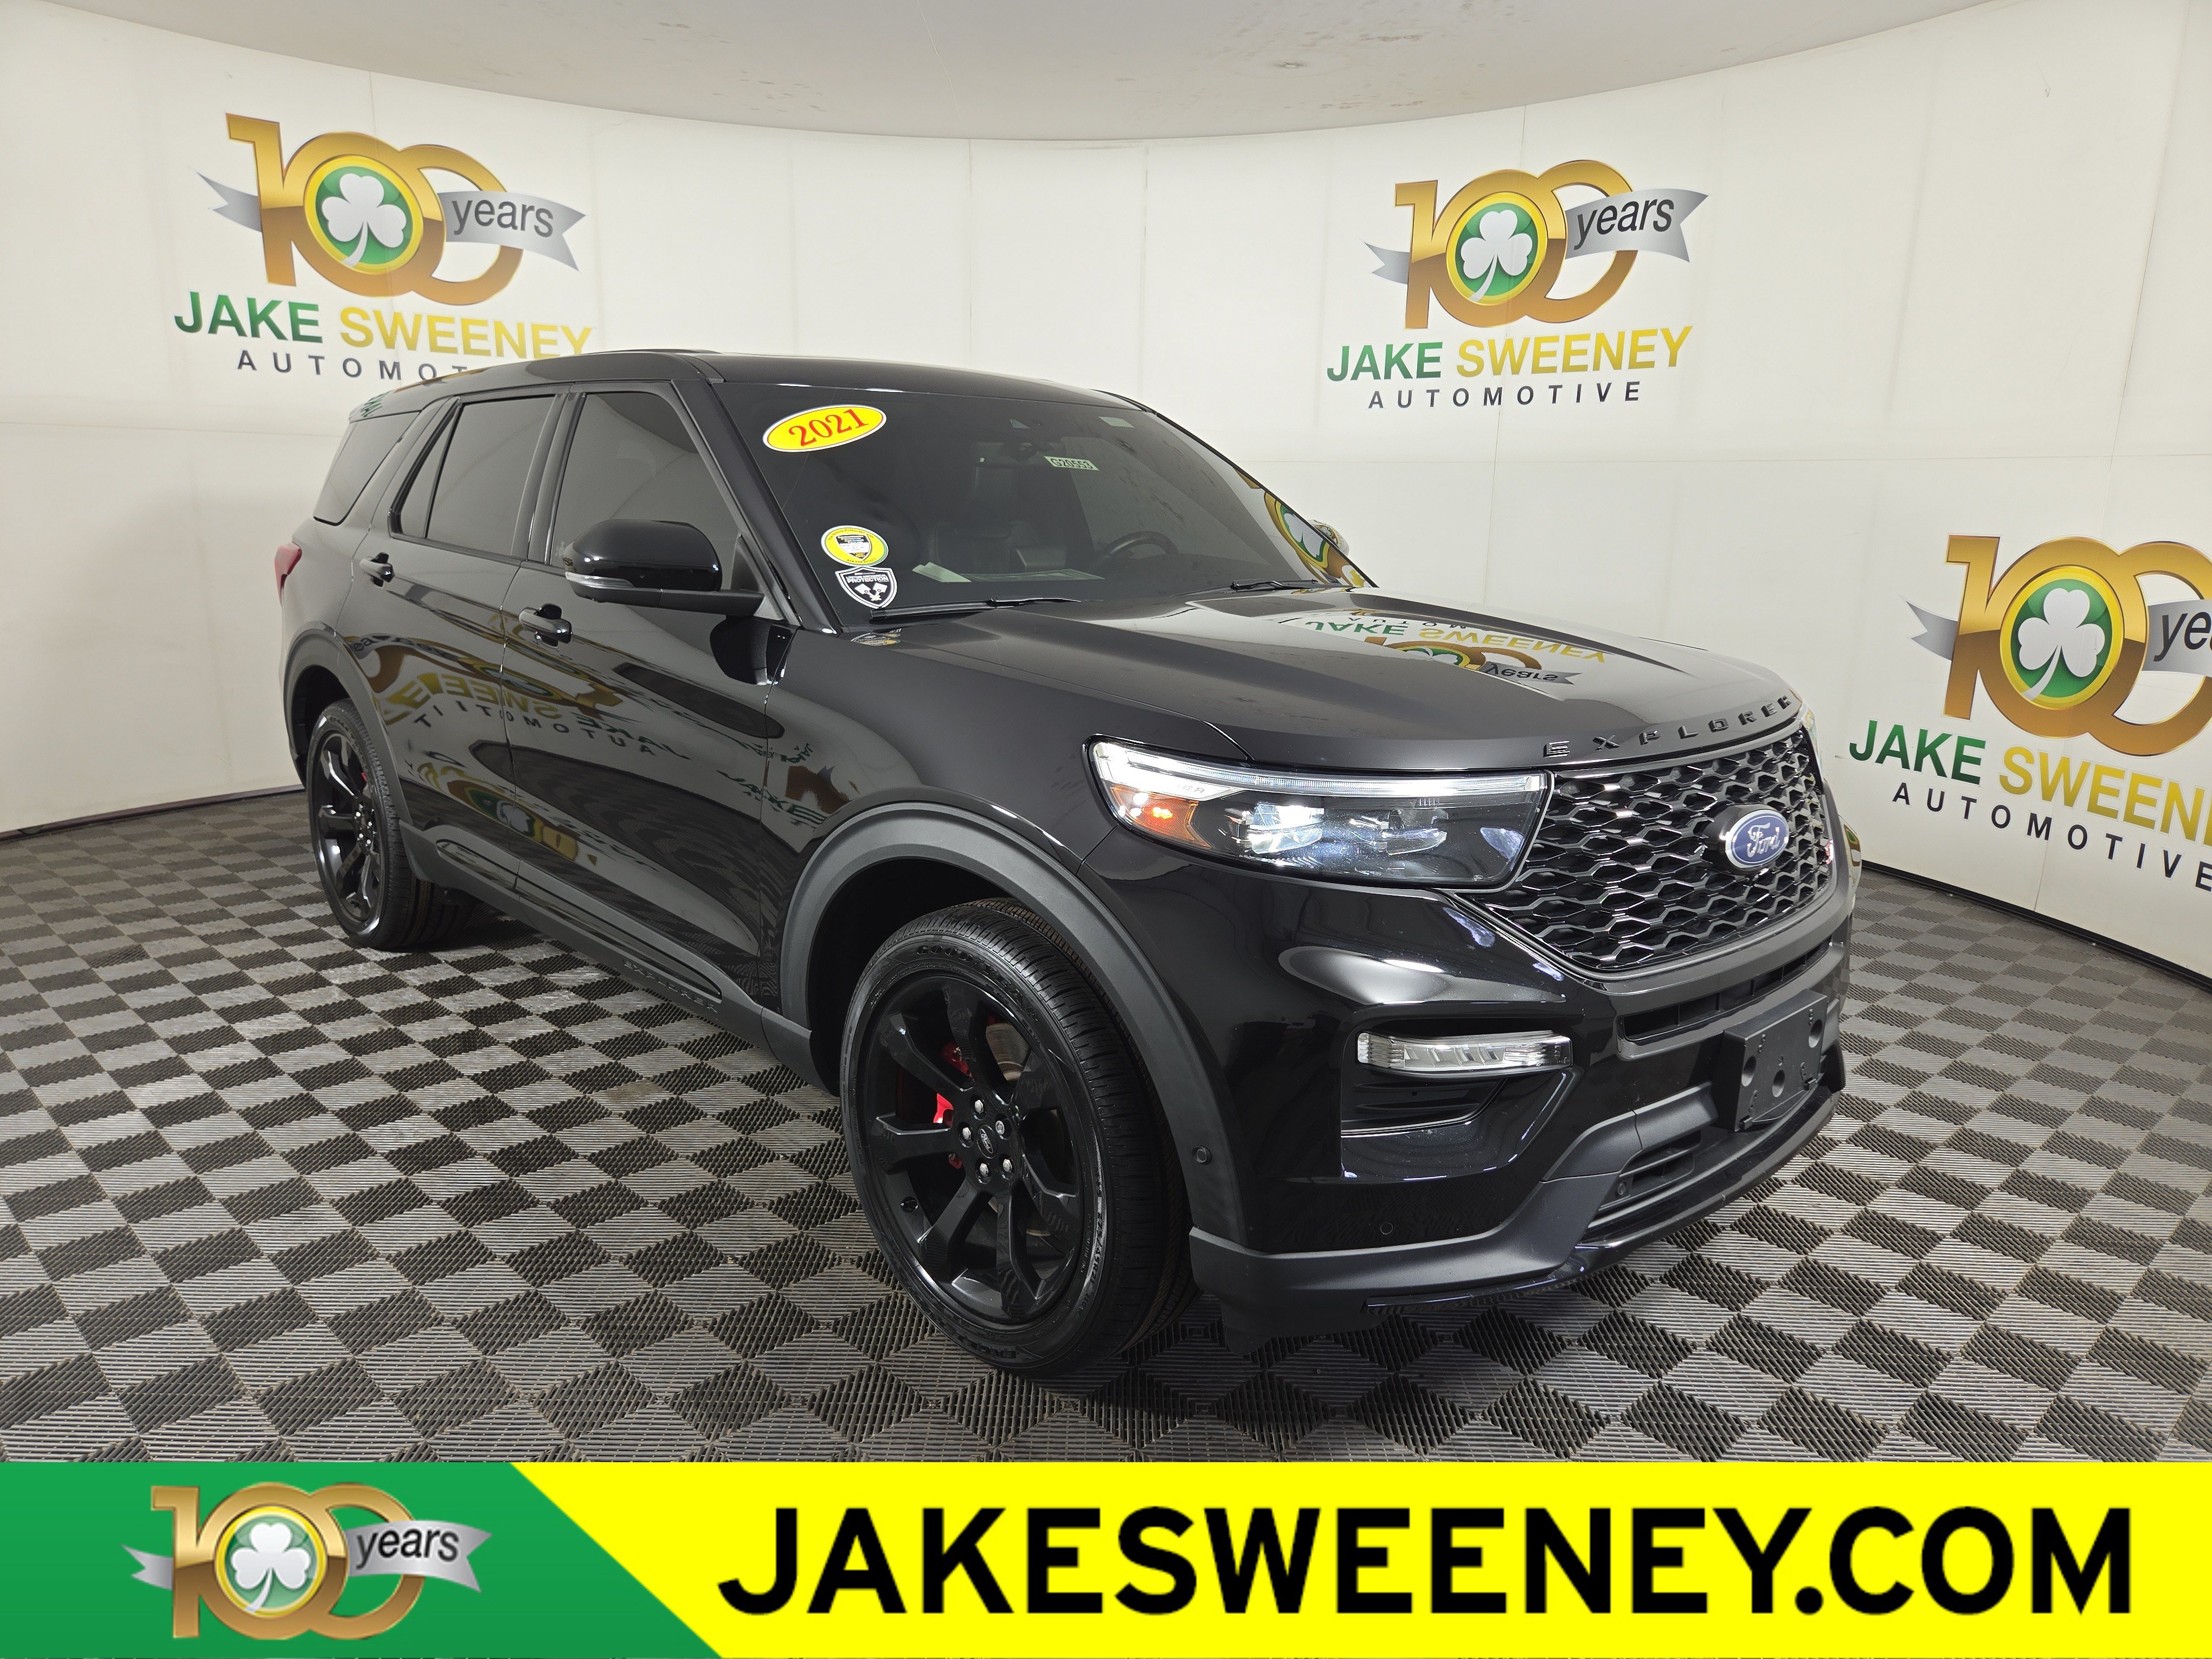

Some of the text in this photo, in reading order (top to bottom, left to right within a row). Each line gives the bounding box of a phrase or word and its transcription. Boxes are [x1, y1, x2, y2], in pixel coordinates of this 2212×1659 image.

[226, 113, 554, 305] 100 years
[1395, 159, 1674, 329] 100 years
[175, 291, 592, 359] JAKE SWEENEY
[237, 350, 467, 384] AUTOMO
[1327, 326, 1693, 382] JAKE SWEENEY
[1368, 381, 1640, 409] AUTOMOTIVE
[789, 409, 869, 446] 2021
[1051, 459, 1093, 469] G20553
[1544, 696, 1792, 758] EXPLORER
[1849, 719, 2212, 847] JAKE SWEEN
[1746, 822, 1780, 858] Ford
[623, 960, 718, 1013] EXPLORER
[917, 945, 1038, 1023] GOODYEAR
